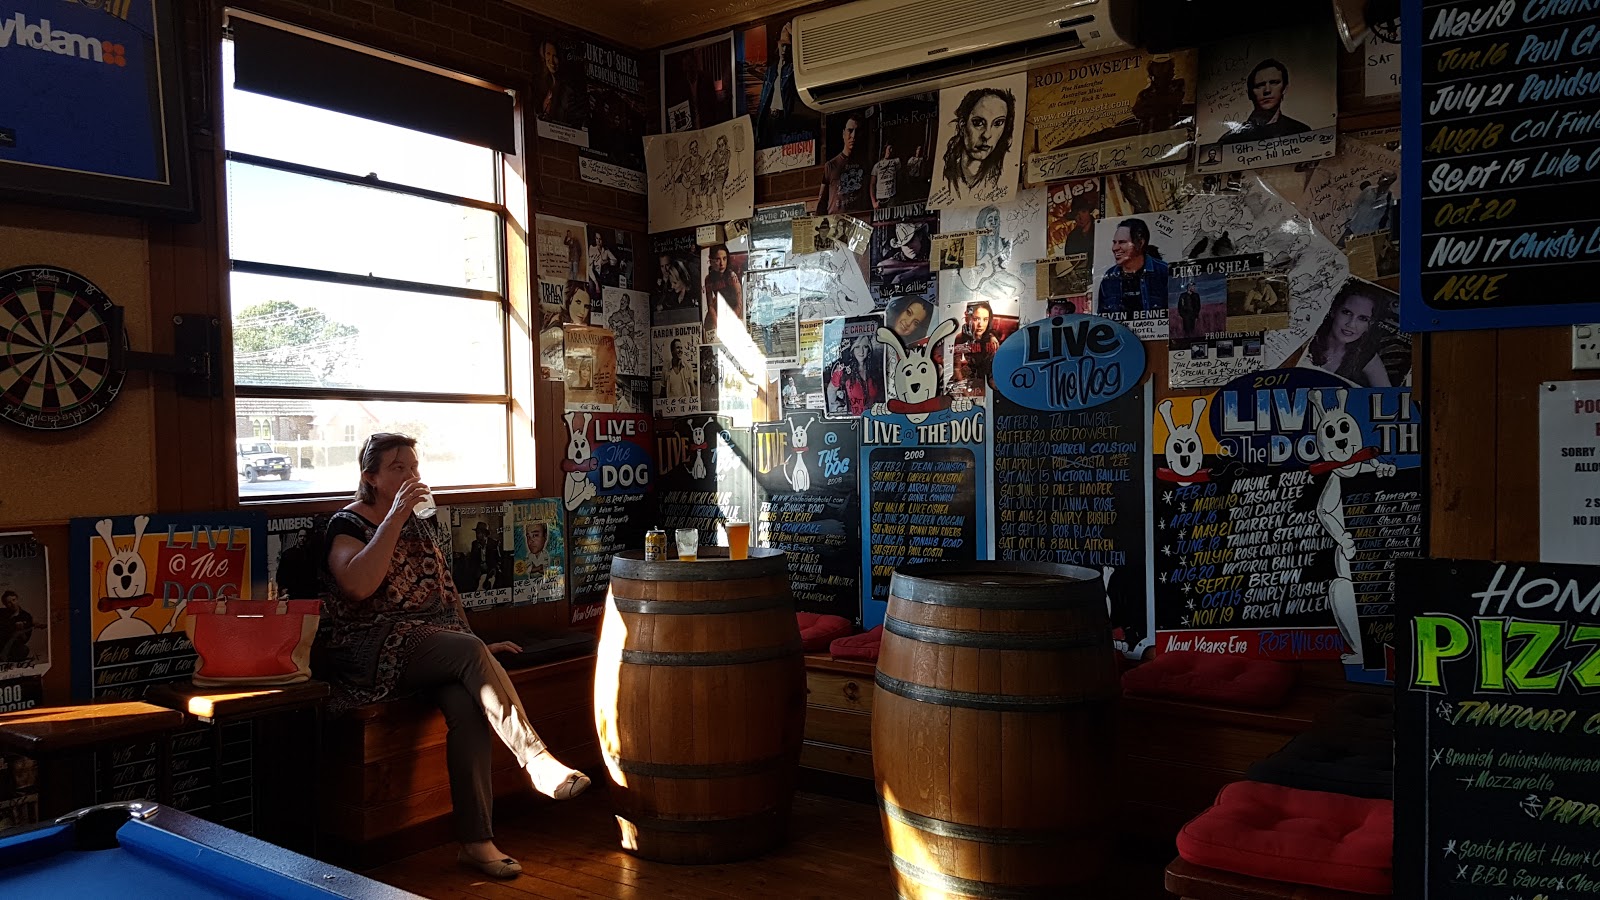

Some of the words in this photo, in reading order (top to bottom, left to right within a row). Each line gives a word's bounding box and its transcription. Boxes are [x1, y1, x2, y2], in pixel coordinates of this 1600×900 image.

[1515, 28, 1569, 64] Paul
[1368, 53, 1394, 67] SAT
[1034, 71, 1063, 89] ROD
[1068, 55, 1143, 81] DOWSETT
[1430, 83, 1487, 115] July
[1485, 83, 1514, 107] 21
[912, 110, 937, 124] Road
[1033, 99, 1131, 123] www.roddowsett.com
[1511, 111, 1558, 142] Col
[1257, 134, 1317, 152] September
[1237, 154, 1262, 166] 9pm
[1282, 145, 1302, 157] late
[1429, 161, 1500, 193] Sept
[1500, 157, 1530, 183] 15
[1532, 152, 1579, 178] Luke
[1483, 238, 1511, 262] 17
[1172, 265, 1202, 278] LUKE
[1207, 260, 1250, 275] O'SHEA
[653, 327, 673, 338] AARON
[675, 325, 700, 336] BOLTON
[1010, 367, 1035, 389] @
[1039, 358, 1077, 407] The
[1078, 356, 1121, 404] Dog
[1253, 373, 1289, 389] 2011
[863, 416, 902, 444] LIVE
[904, 429, 914, 439] @
[917, 423, 948, 443] THE
[950, 412, 983, 443] DOG
[1050, 413, 1075, 428] TALL
[594, 419, 635, 441] LIVE
[637, 420, 648, 433] @
[824, 432, 838, 445] @
[1051, 429, 1069, 441] ROD
[1072, 426, 1121, 441] DOWSETT
[606, 446, 631, 463] The
[904, 450, 925, 460] 2009
[1051, 442, 1086, 454] DARREN
[1090, 441, 1137, 452] COLSTON
[1216, 438, 1238, 460] @
[1240, 436, 1266, 463] The
[1562, 447, 1595, 457] SORRY
[818, 447, 841, 467] THE
[824, 458, 850, 478] DOG
[911, 462, 932, 471] DEAN
[602, 464, 649, 489] DOG
[1053, 470, 1092, 482] VICTORIA
[1096, 469, 1130, 482] BAILLIE
[1231, 475, 1272, 493] WAYNE
[1053, 483, 1074, 495] DALE
[1080, 483, 1114, 495] HOOPER
[1239, 490, 1278, 504] JASON
[1281, 486, 1304, 499] LEE
[1052, 498, 1088, 511] LIANNA
[1094, 497, 1116, 511] ROSE
[1229, 508, 1253, 521] TORI
[1255, 500, 1297, 517] DARKE
[1346, 505, 1368, 515] MAR
[1018, 510, 1034, 521] AUG
[1037, 510, 1046, 522] 21
[1050, 512, 1086, 524] SIMPLY
[1087, 512, 1118, 524] BUSHED
[1235, 515, 1283, 533] DARREN
[1349, 517, 1374, 526] APRIL
[1574, 516, 1587, 525] NO
[165, 524, 245, 551] LIVE
[1053, 525, 1069, 537] ROB
[1073, 525, 1103, 539] BLACK
[1227, 531, 1268, 548] TAMARA
[1355, 528, 1376, 538] MAY
[923, 547, 944, 557] COSTA
[1084, 538, 1114, 550] AITKEN
[1357, 538, 1383, 549] JUNE
[1056, 550, 1086, 565] TRACY
[1090, 550, 1126, 565] KILLEEN
[1234, 546, 1257, 561] ROSE
[1356, 551, 1380, 560] JULY
[169, 553, 186, 573] @
[190, 552, 229, 579] The
[1222, 559, 1268, 575] VICTORIA
[1272, 553, 1317, 570] BAILLIE
[1354, 562, 1376, 571] AUG
[1249, 569, 1302, 587] BREWN
[1356, 572, 1382, 581] SEPT
[1243, 585, 1288, 603] SIMPLY
[1360, 583, 1382, 592] OCT
[462, 600, 474, 608] SAT
[1242, 603, 1281, 620] BRYEN
[1362, 605, 1388, 614] DEC
[1165, 635, 1192, 653] New
[1194, 632, 1227, 654] Years
[1229, 636, 1248, 653] Eve
[1258, 632, 1289, 657] ROB
[1291, 632, 1345, 655] WILSON
[1451, 701, 1576, 733] TANDOORI
[1446, 748, 1494, 768] Spanish
[1475, 770, 1555, 791] Mozzarella
[1459, 840, 1504, 861] Scotch
[1513, 869, 1557, 888] Sauce
